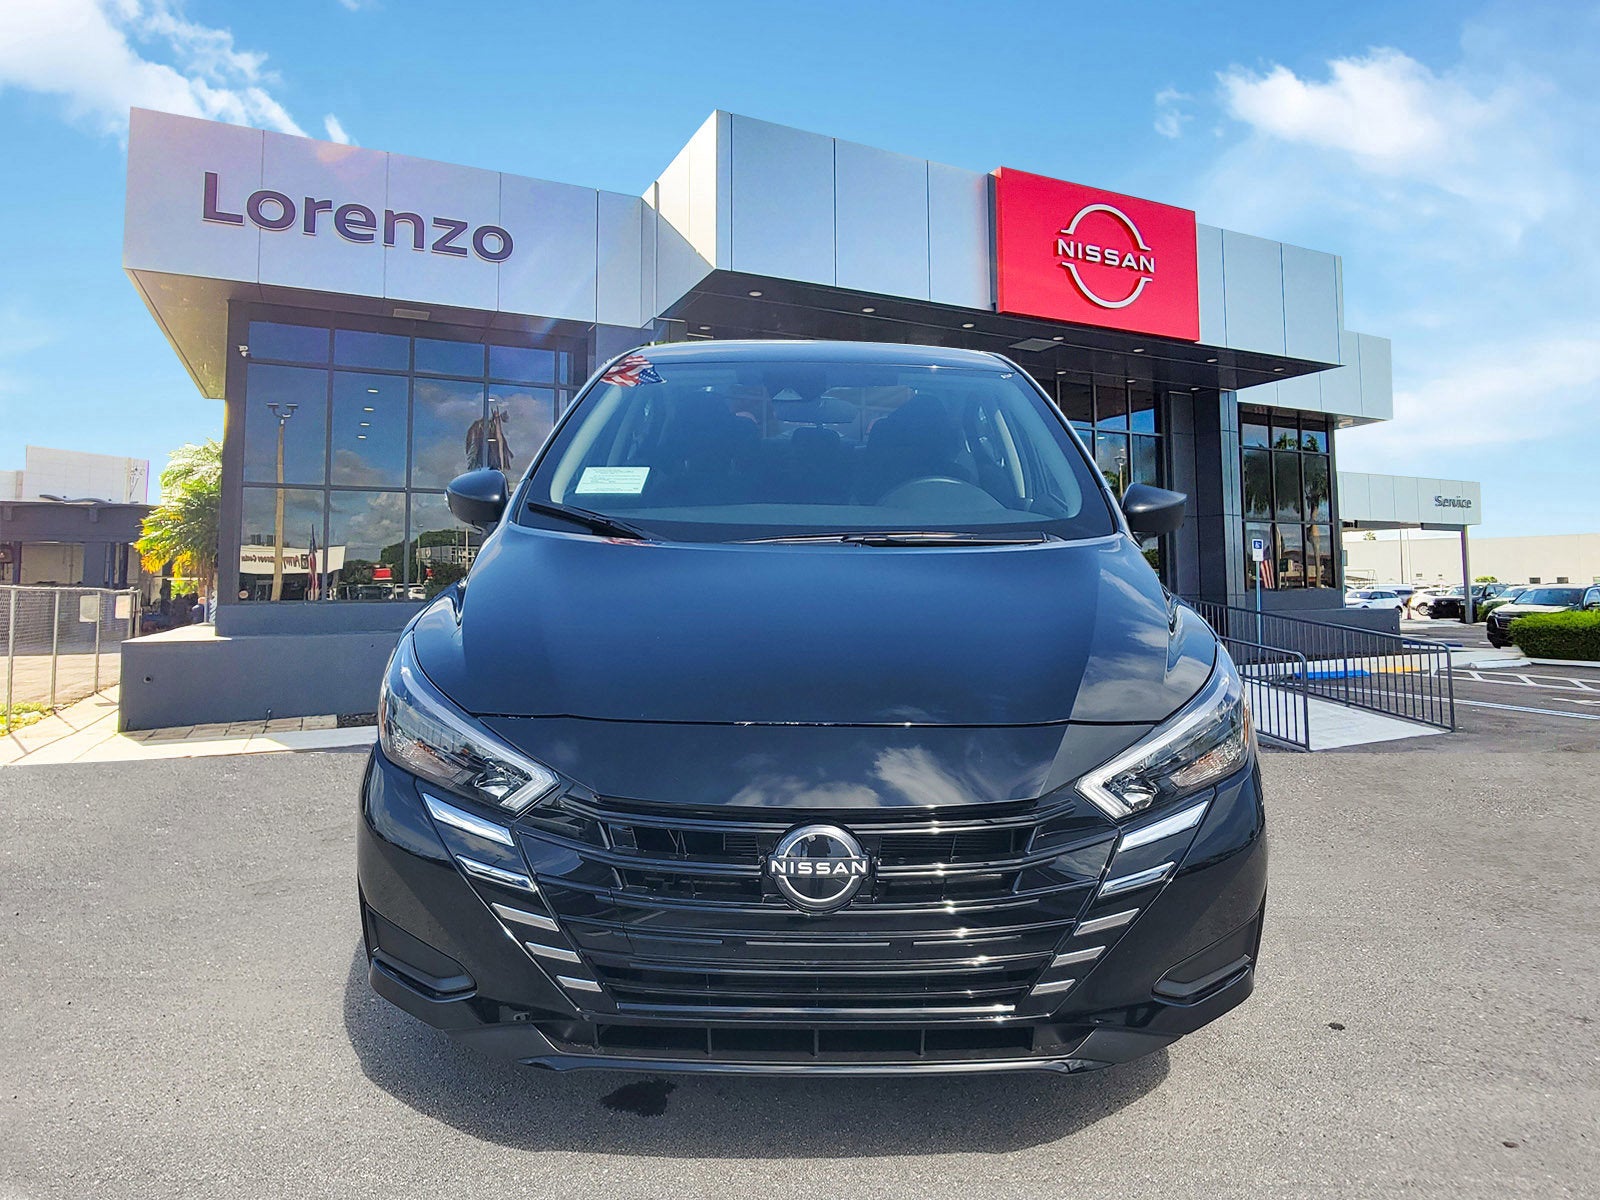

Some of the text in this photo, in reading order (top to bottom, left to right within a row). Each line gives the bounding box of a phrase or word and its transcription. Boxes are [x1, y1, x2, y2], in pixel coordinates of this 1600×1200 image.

[202, 170, 514, 262] Lorenzo
[1057, 238, 1155, 273] NISSAN
[1434, 496, 1472, 509] Service
[771, 860, 867, 875] NISSAN
